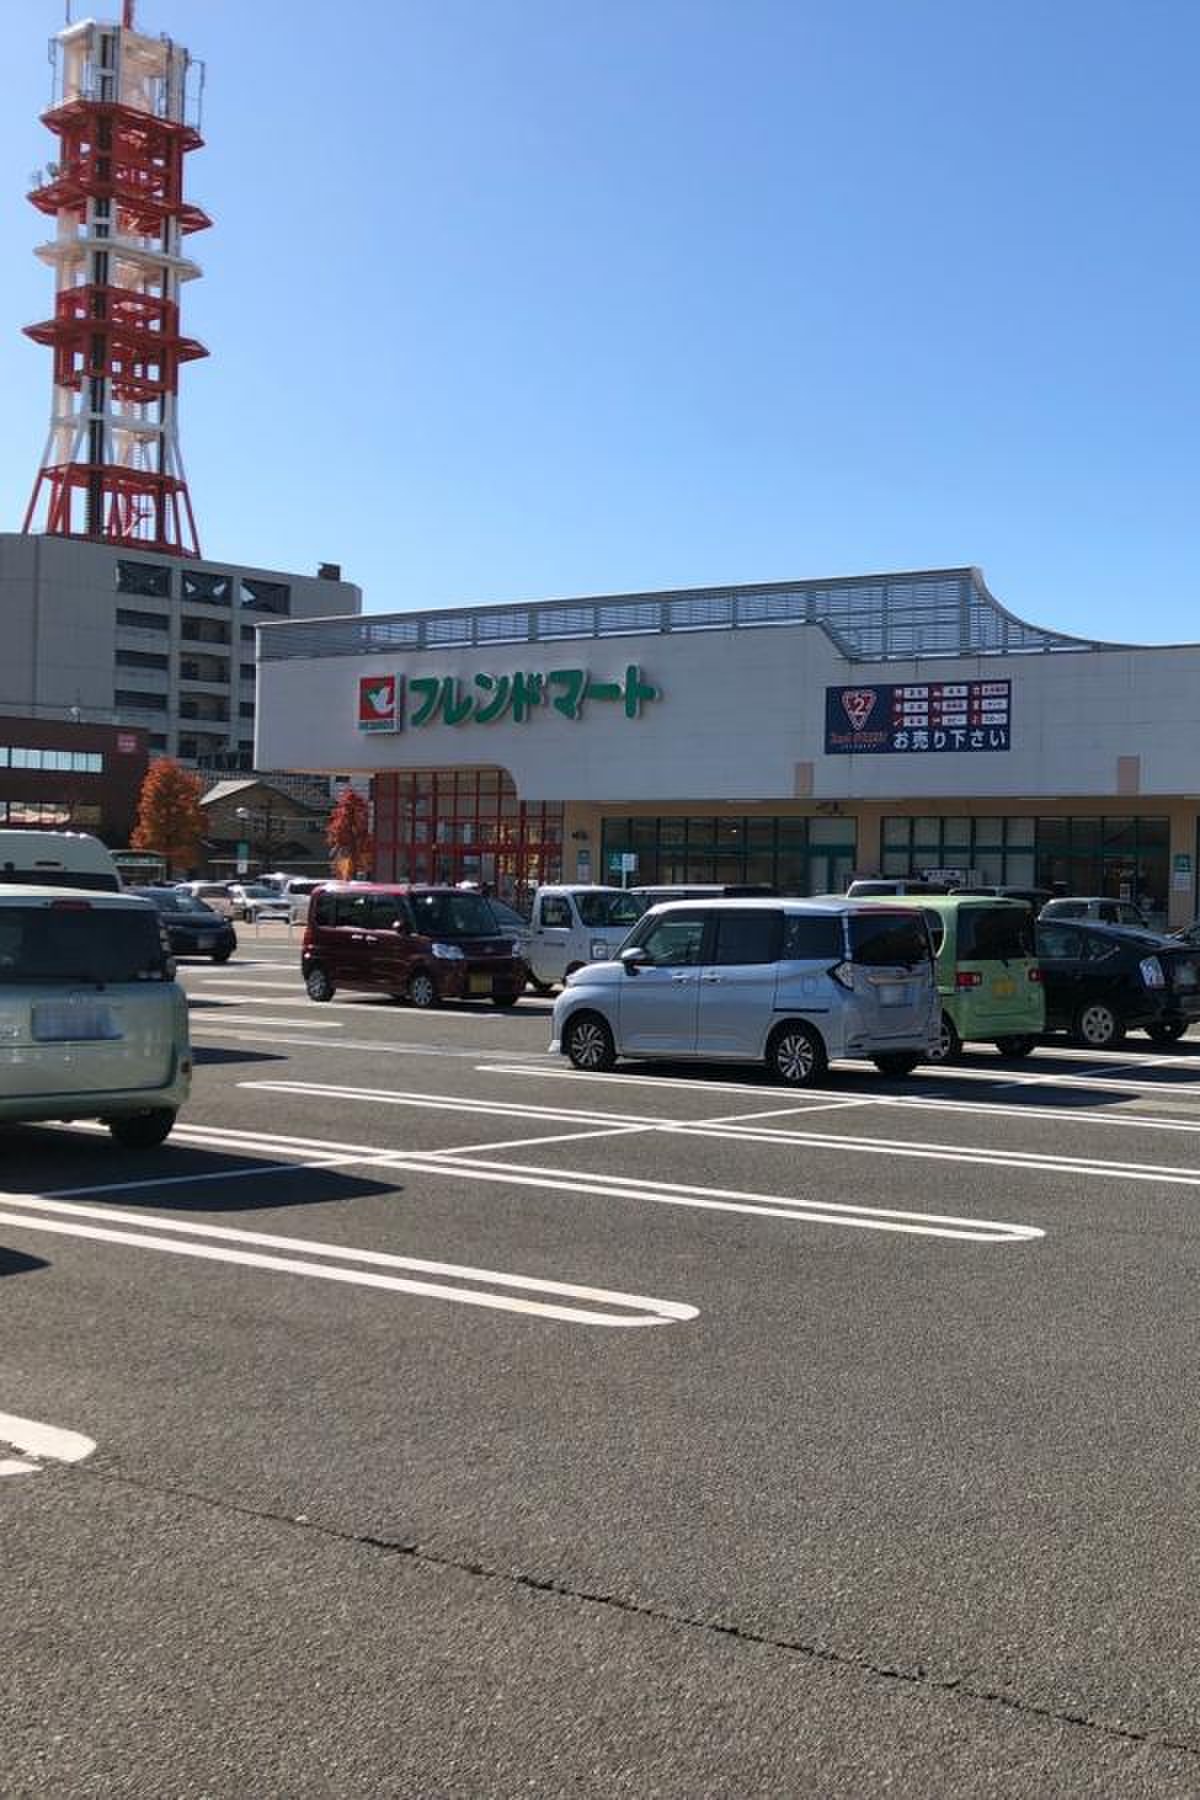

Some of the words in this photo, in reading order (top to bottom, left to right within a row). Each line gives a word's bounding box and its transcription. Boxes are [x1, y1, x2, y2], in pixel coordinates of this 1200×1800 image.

[408, 665, 659, 726] フレンドマート
[893, 729, 1006, 749] お売り下さい
